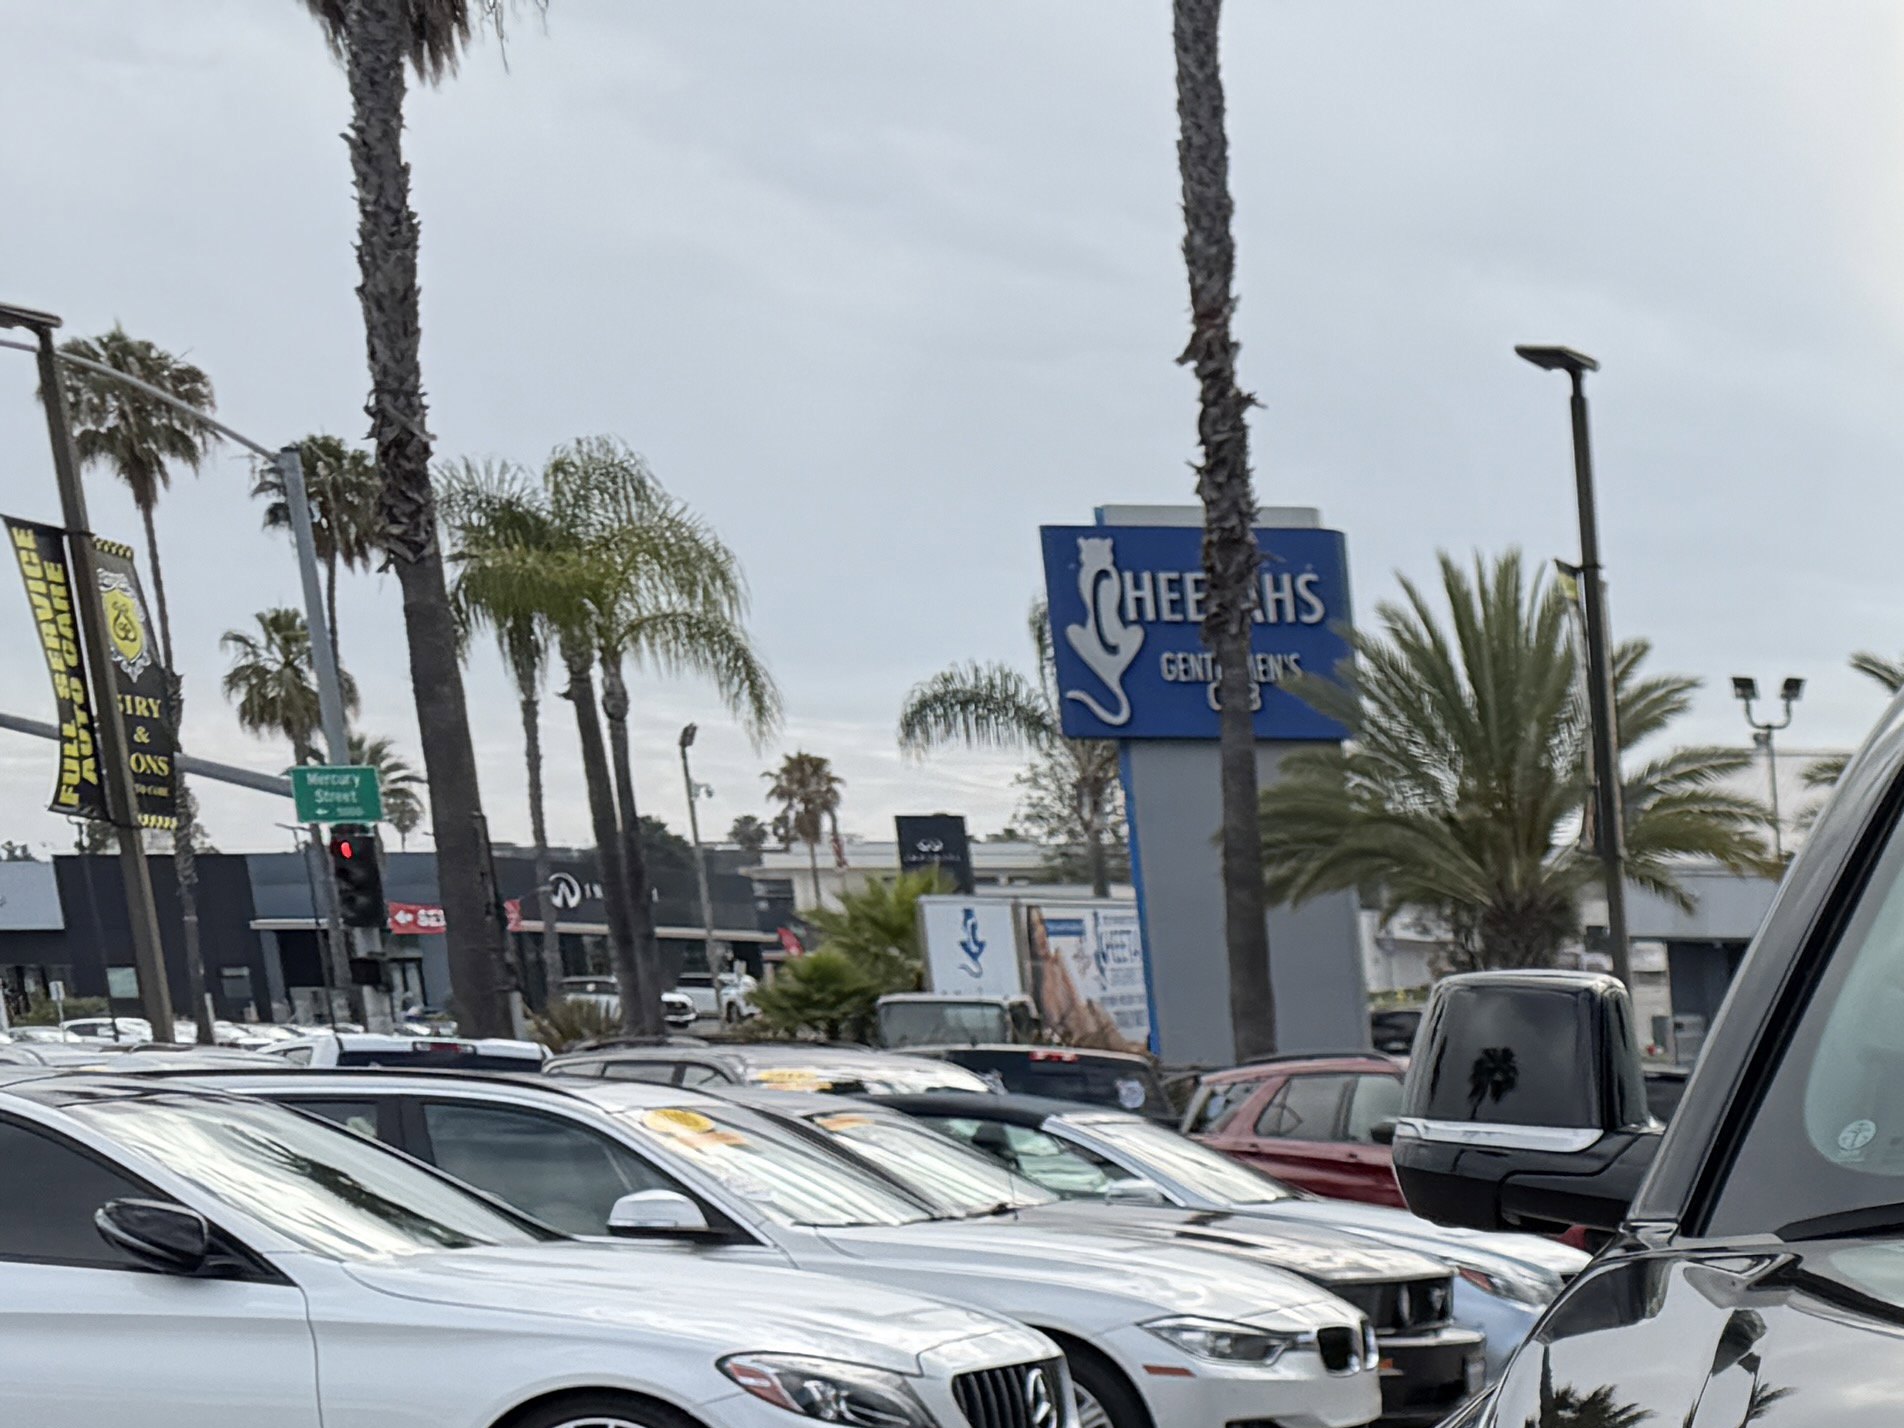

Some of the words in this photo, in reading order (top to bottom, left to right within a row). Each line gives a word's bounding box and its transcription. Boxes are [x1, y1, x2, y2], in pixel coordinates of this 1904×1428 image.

[11, 526, 71, 701] SERVICE
[43, 560, 79, 669] CARE
[58, 722, 80, 807] FULL
[67, 676, 99, 785] AUTO
[129, 751, 170, 778] ONS
[306, 772, 361, 789] Mercury
[314, 788, 358, 804] Street
